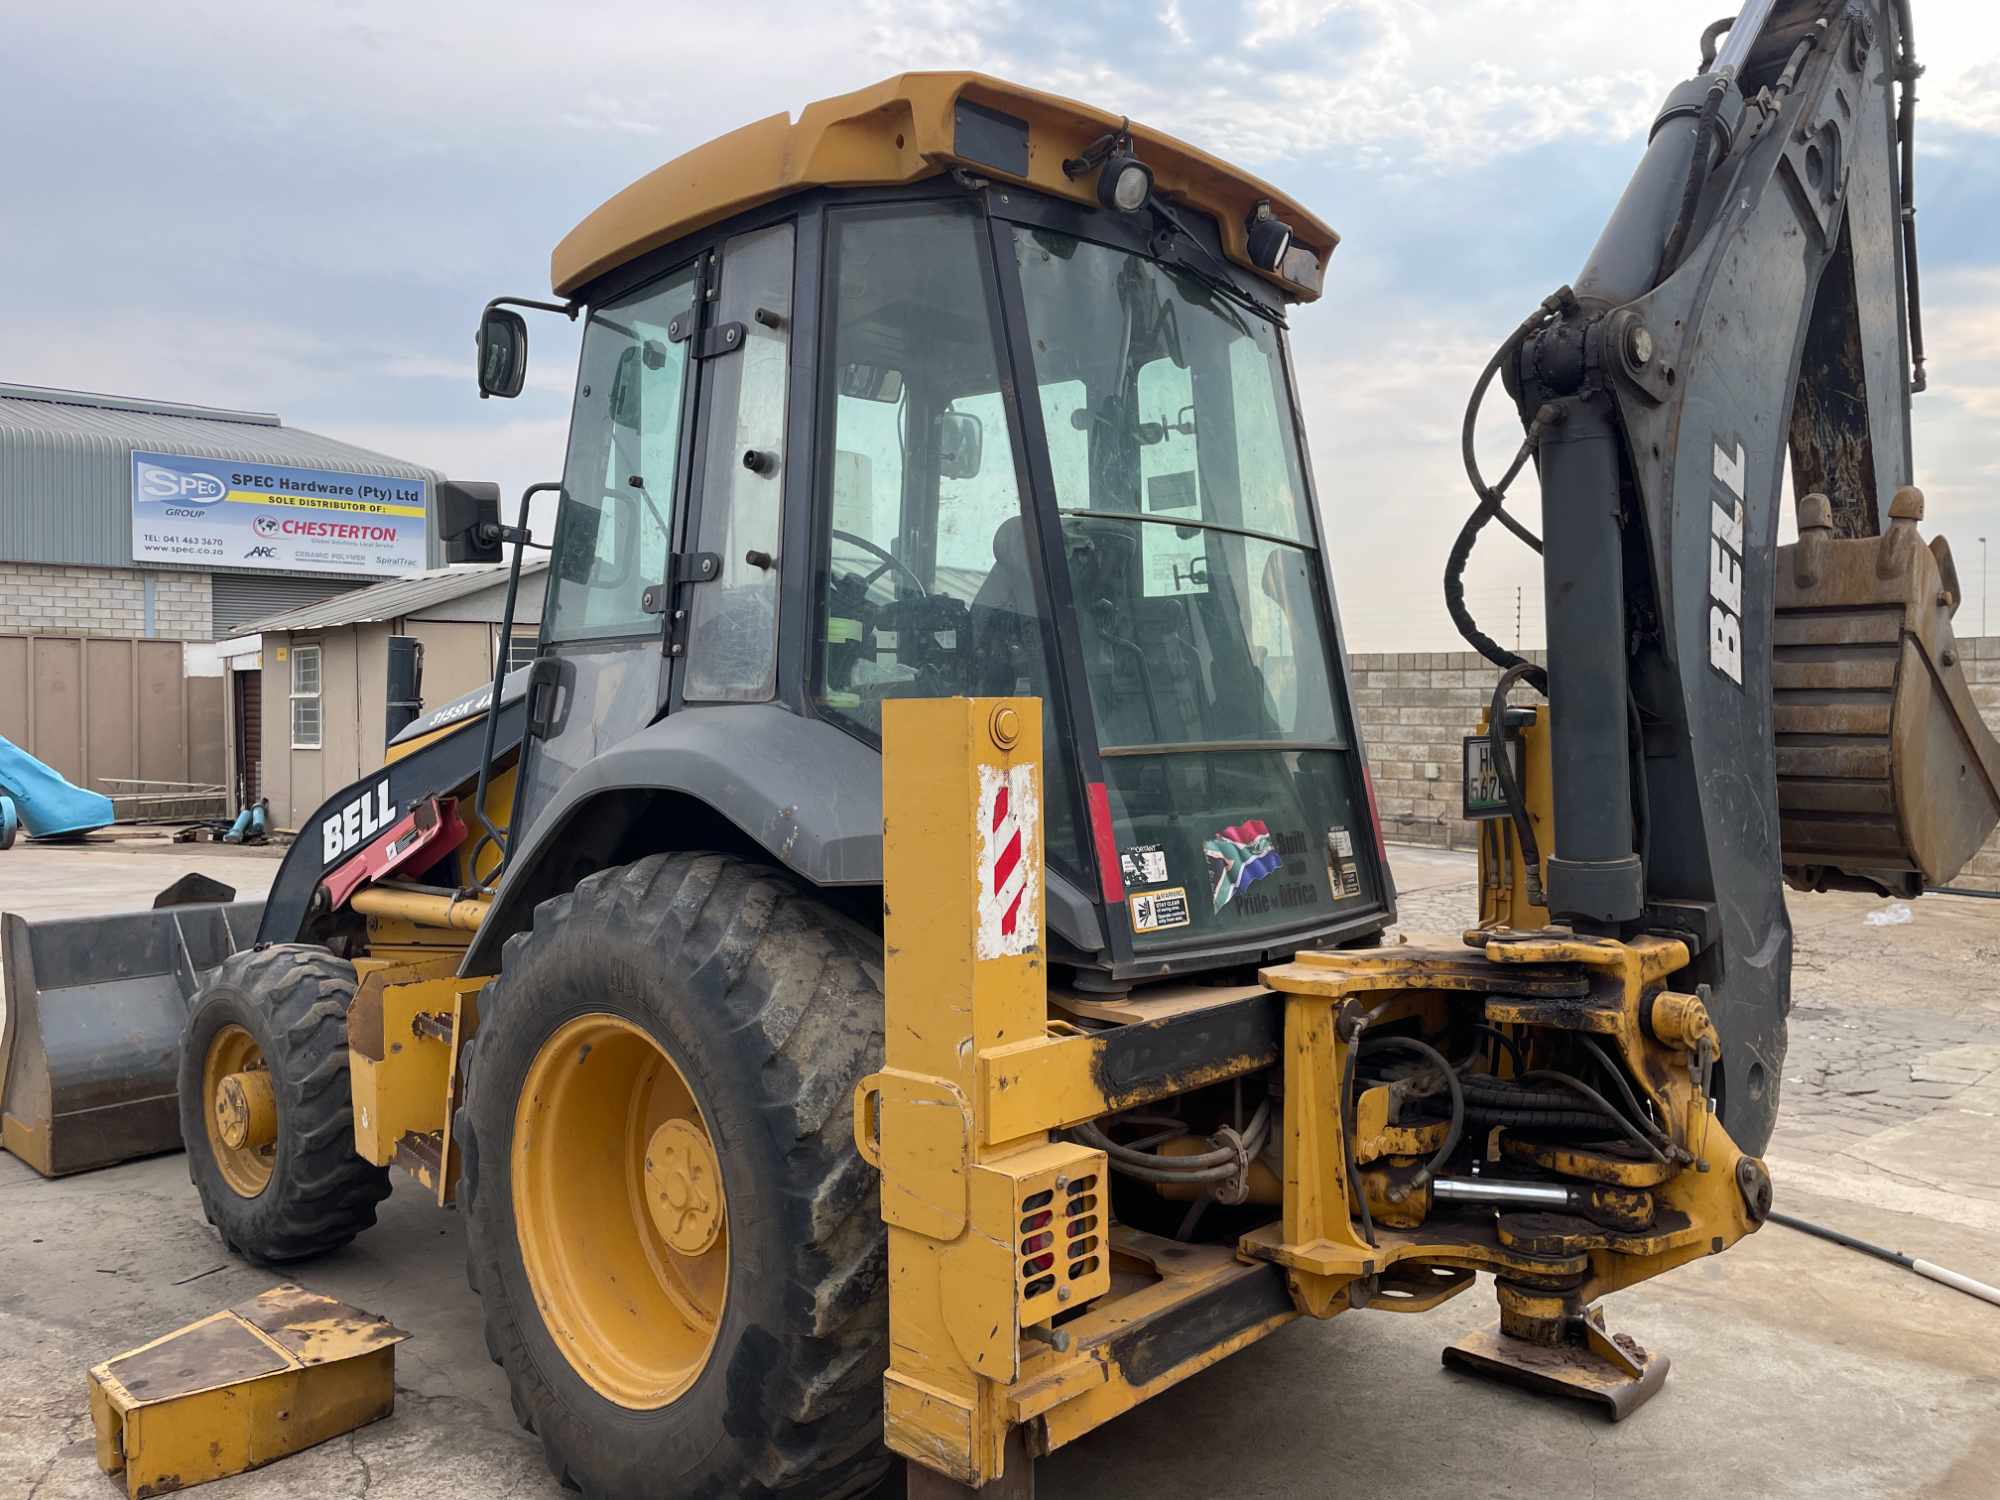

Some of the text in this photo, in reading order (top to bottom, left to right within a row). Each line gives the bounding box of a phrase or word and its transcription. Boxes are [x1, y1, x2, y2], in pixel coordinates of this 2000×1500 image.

[143, 469, 217, 497] SPEC
[231, 473, 419, 503] SPEC Hardware (Pty) Ltd
[165, 508, 206, 519] GROUP
[268, 496, 387, 514] SOLE DISTRIBUTOR OF:
[144, 534, 161, 543] TEL:
[163, 535, 180, 544] 041
[281, 519, 397, 542] CHESTERTON
[244, 546, 278, 559] ARC
[1710, 442, 1745, 685] BELL
[323, 779, 396, 864] BELL
